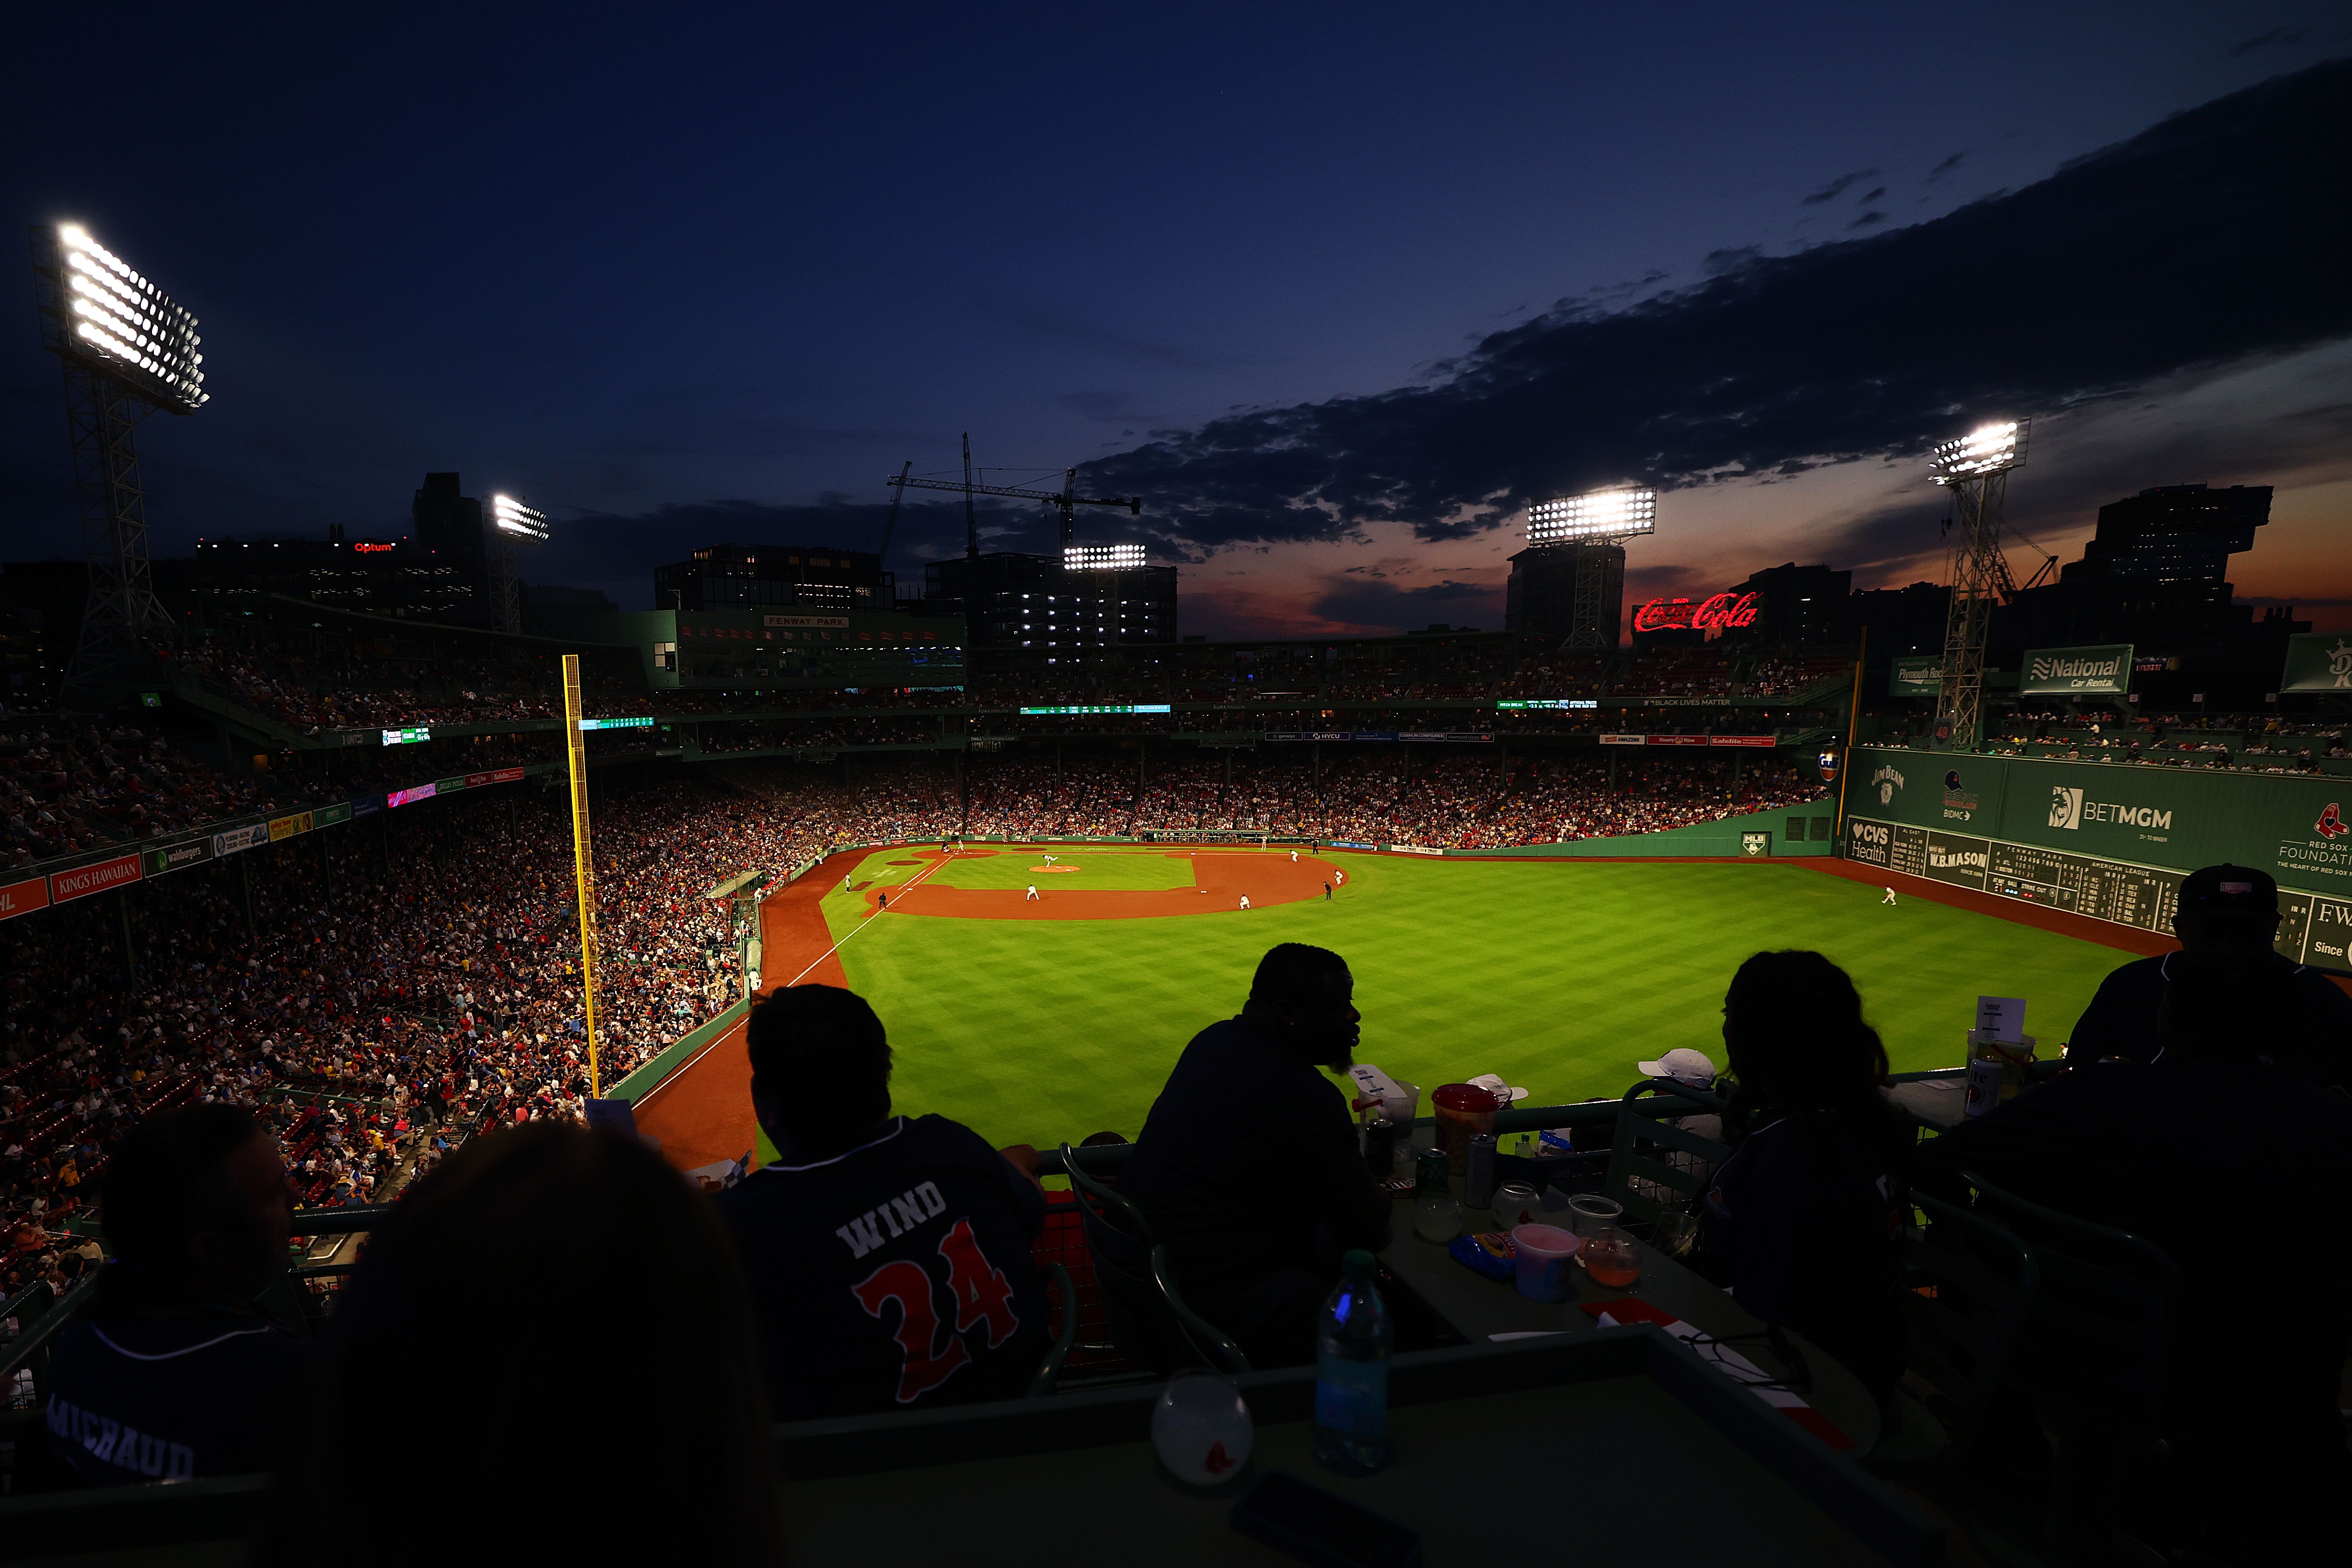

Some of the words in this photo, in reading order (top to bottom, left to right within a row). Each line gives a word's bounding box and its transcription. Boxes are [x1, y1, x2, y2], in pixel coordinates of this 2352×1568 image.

[355, 543, 391, 553] Optum
[1634, 592, 1764, 632] Coca-Cola
[1898, 667, 1929, 680] Plymouth
[1929, 667, 1943, 679] Roc
[2049, 656, 2121, 677] National
[2071, 679, 2085, 687] Car
[2086, 678, 2115, 687] Rental
[1819, 754, 1839, 768] Gulf
[1871, 768, 1885, 787] JIM
[1885, 764, 1905, 791] BEAM
[1943, 808, 1964, 820] BIDMC
[2083, 801, 2173, 830] BETMGM
[1863, 824, 1889, 845] CVS
[168, 846, 201, 863] wahlburgers
[1851, 840, 1886, 863] Health
[2007, 846, 2037, 856] FENWAY
[2042, 852, 2063, 861] PARK
[2309, 840, 2327, 849] RED
[2329, 843, 2348, 852] SOX
[58, 873, 90, 894] KING'S
[91, 862, 137, 886] HAWAIIAN
[2091, 862, 2123, 872] AMERICAN
[2125, 867, 2150, 877] LEAGUE
[2314, 940, 2343, 957] Since
[835, 1180, 947, 1260] WIND
[850, 1216, 1020, 1404] 24
[46, 1392, 194, 1482] MICHAUD
